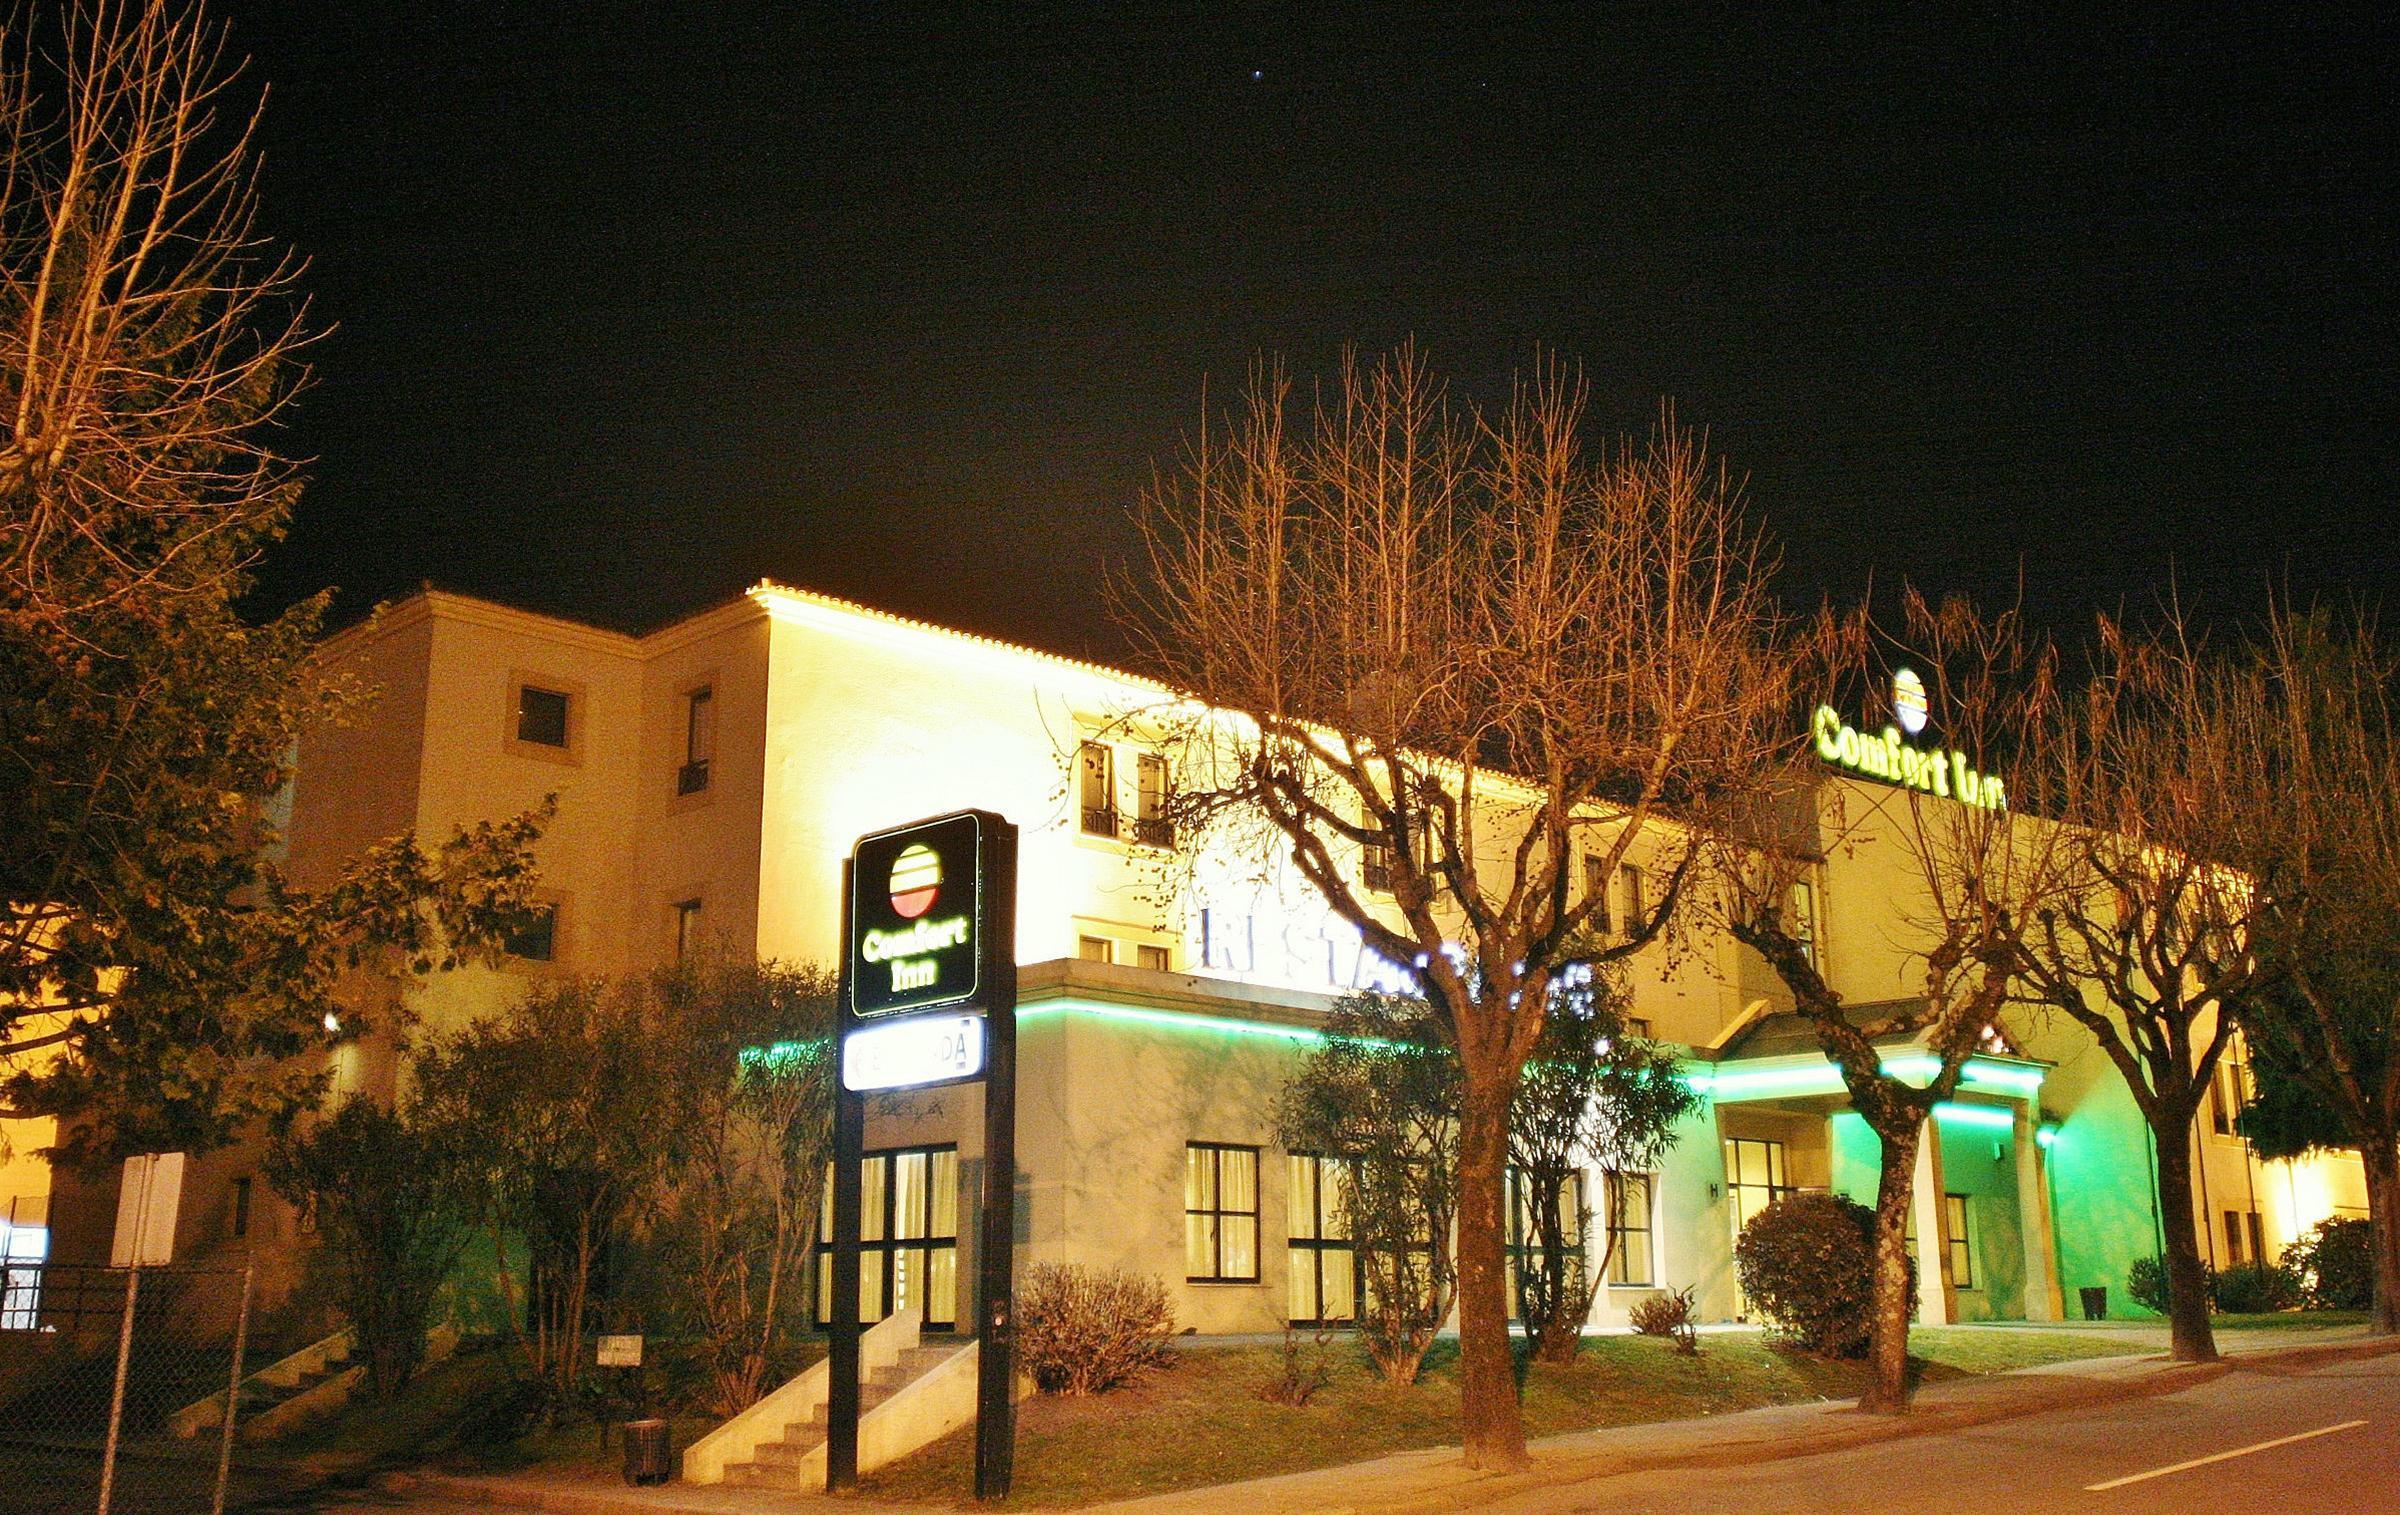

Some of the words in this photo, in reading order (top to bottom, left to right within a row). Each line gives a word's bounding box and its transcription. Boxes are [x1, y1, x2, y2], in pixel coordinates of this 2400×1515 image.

[1815, 705, 1949, 797] Comfort
[862, 917, 967, 963] Comfort
[890, 959, 936, 993] Inn
